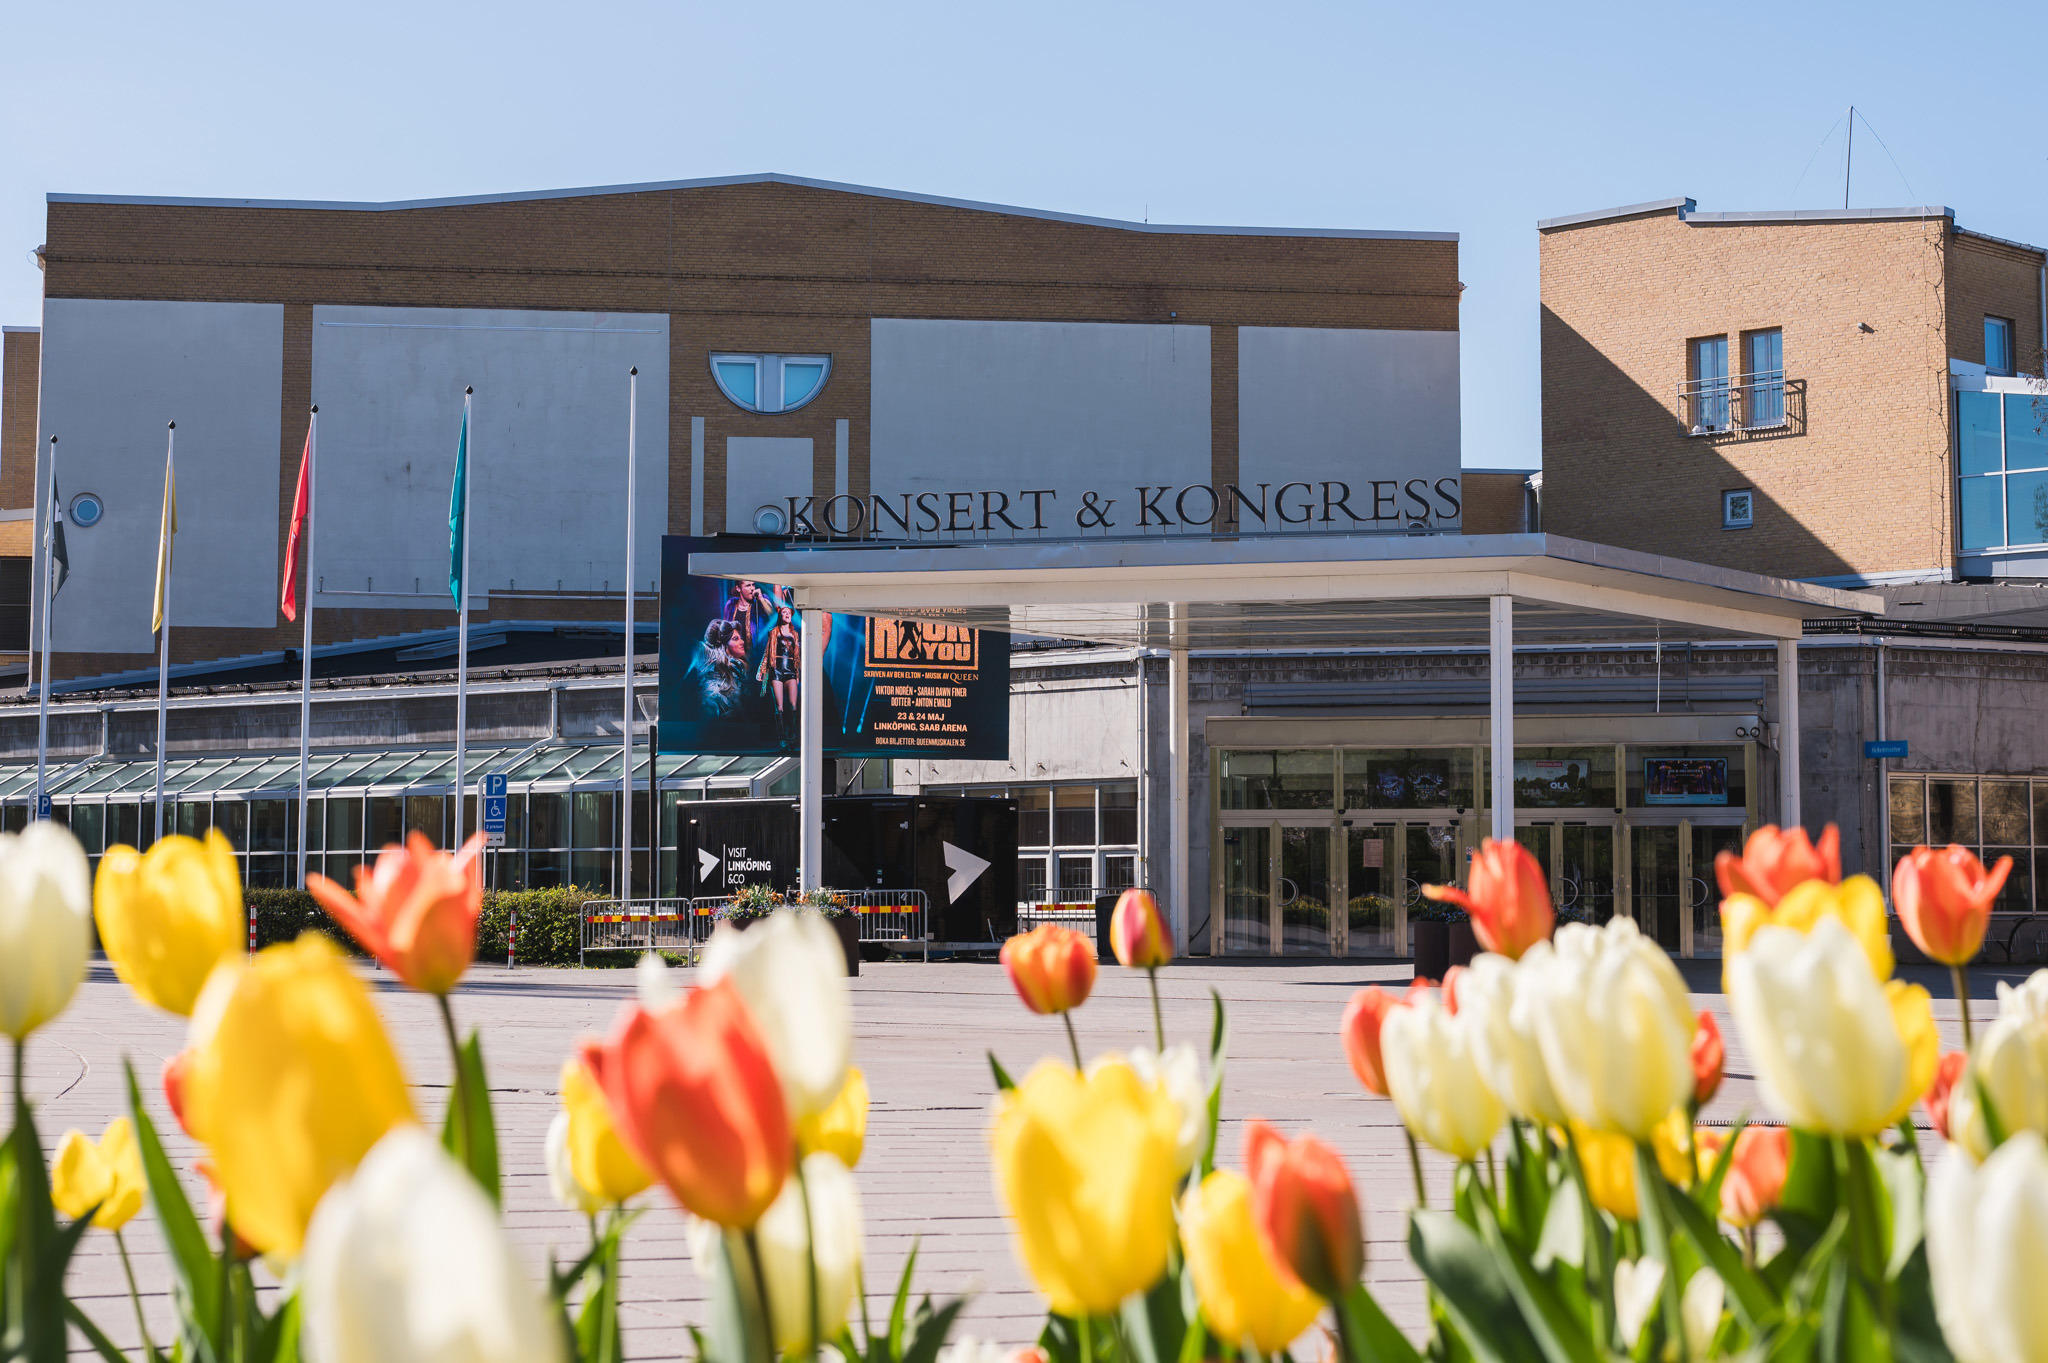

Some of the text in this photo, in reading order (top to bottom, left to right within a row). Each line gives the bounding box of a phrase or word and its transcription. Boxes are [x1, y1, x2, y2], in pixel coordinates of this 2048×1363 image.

[784, 477, 1462, 535] KONSERT & KONGRESS
[922, 642, 971, 661] YOU
[864, 670, 886, 678] SKRIVEN
[894, 671, 904, 679] BEN
[905, 671, 921, 679] ELTON
[942, 672, 949, 680] AV
[950, 672, 979, 684] QUEEN
[875, 684, 967, 698] VIKTOR NORÉN SARAH DAWN FINER
[891, 696, 952, 708] DOTTER ANTON EWALD
[897, 712, 907, 720] 23
[927, 713, 945, 721] MAJ
[874, 722, 968, 732] LINKÖPING, SAAB ARENA
[875, 737, 966, 746] BOKA BILJETTER: QUEENMUSIKALEN.SE
[492, 776, 502, 794] P
[42, 796, 49, 813] P
[728, 848, 746, 858] VISIT
[728, 858, 771, 871] LINKÖPING
[728, 874, 745, 884] &CO
